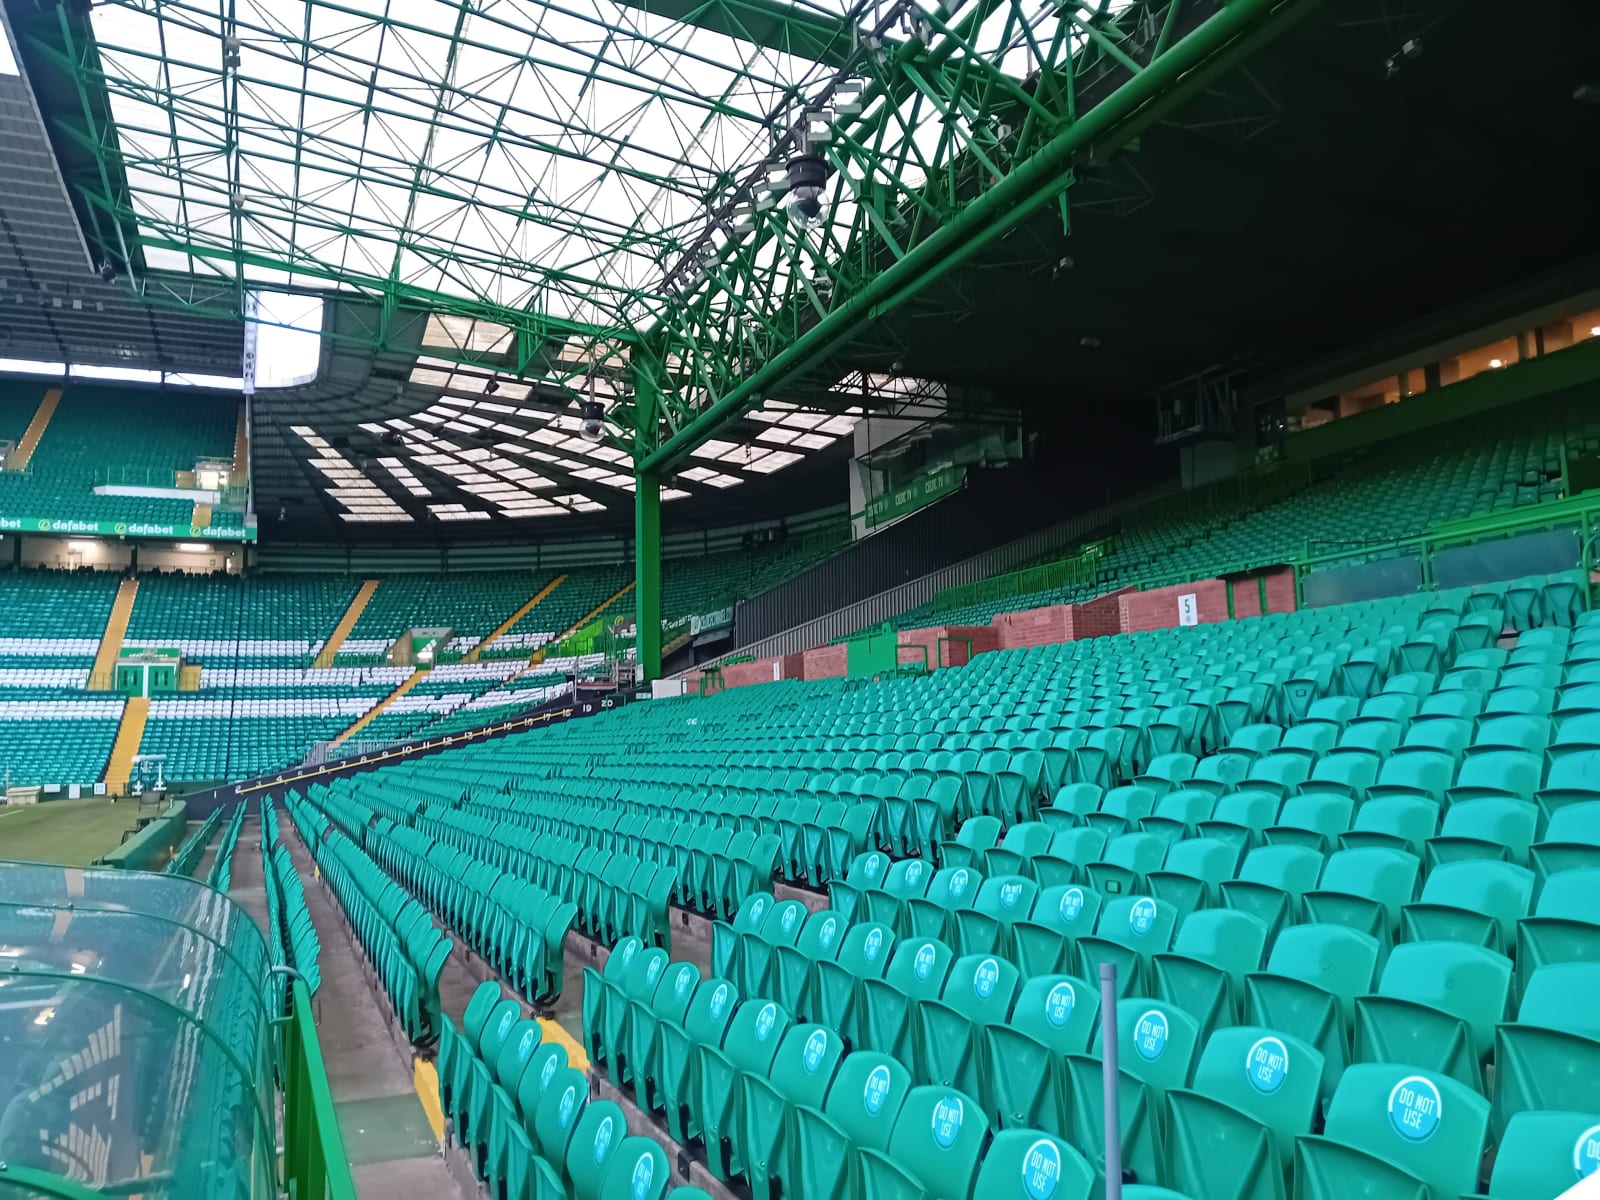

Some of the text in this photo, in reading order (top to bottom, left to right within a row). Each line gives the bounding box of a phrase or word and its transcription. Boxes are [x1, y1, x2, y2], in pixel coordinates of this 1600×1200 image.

[52, 520, 98, 532] dafabet
[128, 523, 174, 535] dafabet
[202, 526, 246, 538] dafabet
[1184, 598, 1190, 614] 5
[582, 704, 592, 712] 19
[601, 699, 614, 708] 20
[402, 746, 412, 755] 10
[235, 785, 242, 794] 2
[1052, 992, 1071, 1008] DO NOT
[1054, 1006, 1064, 1019] USE
[1142, 1020, 1164, 1040] DO NOT
[1144, 1036, 1156, 1051] USE
[1255, 1047, 1284, 1071] DO NOT
[1258, 1066, 1274, 1084] USE
[1399, 1087, 1435, 1115] DO NOT
[939, 1104, 959, 1124] DO NOT
[1403, 1109, 1424, 1130] USE
[940, 1122, 952, 1138] USE
[1031, 1151, 1056, 1177] DO NOT
[1033, 1170, 1048, 1192] USE
